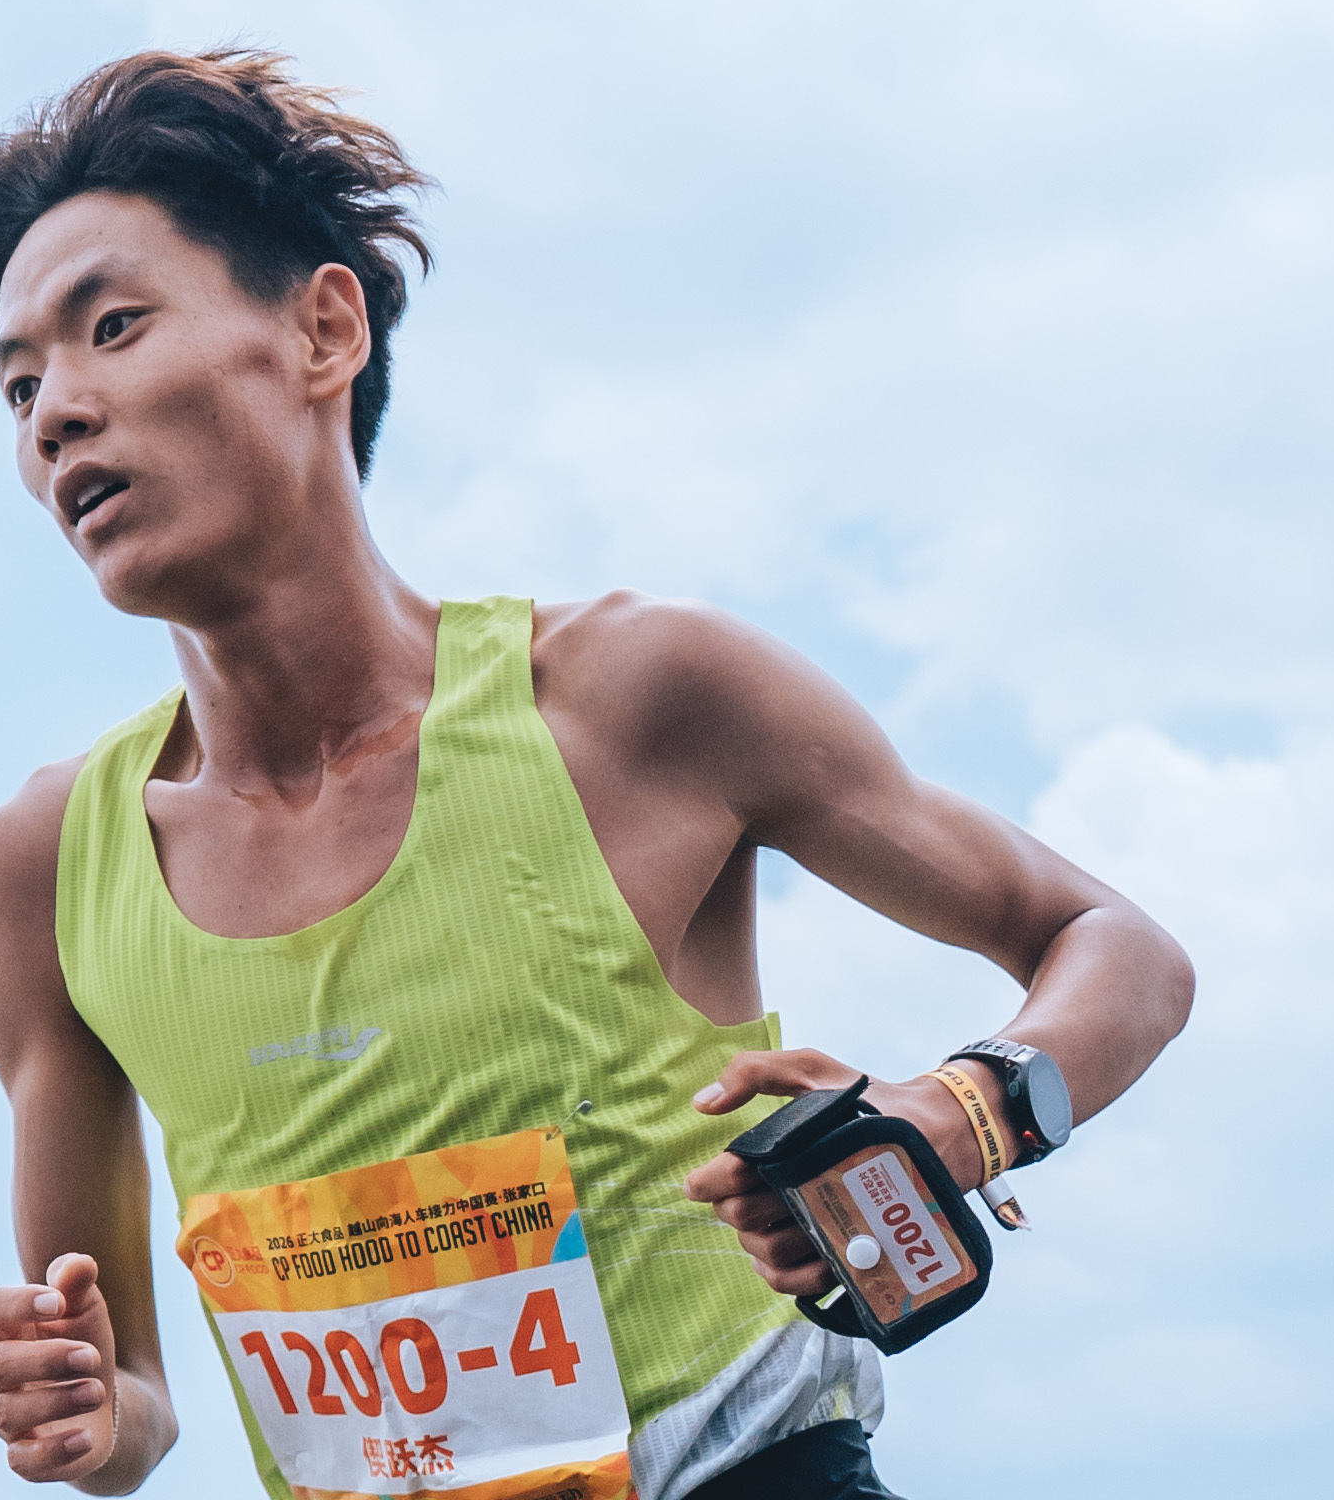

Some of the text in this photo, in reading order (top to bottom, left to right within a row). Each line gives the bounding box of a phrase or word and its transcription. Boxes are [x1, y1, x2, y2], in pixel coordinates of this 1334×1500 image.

[249, 1026, 352, 1067] saucony
[963, 1089, 977, 1101] CP
[971, 1102, 989, 1129] FOOD
[982, 1128, 1000, 1157] HOOD
[990, 1156, 1002, 1172] TO
[266, 1235, 295, 1251] 2026
[297, 1226, 345, 1248] 正大食品
[271, 1200, 554, 1282] CP FOOD HOOD TO COAST CHINA
[881, 1202, 944, 1284] 1200
[201, 1250, 225, 1272] CP
[239, 1287, 581, 1418] 1200-4
